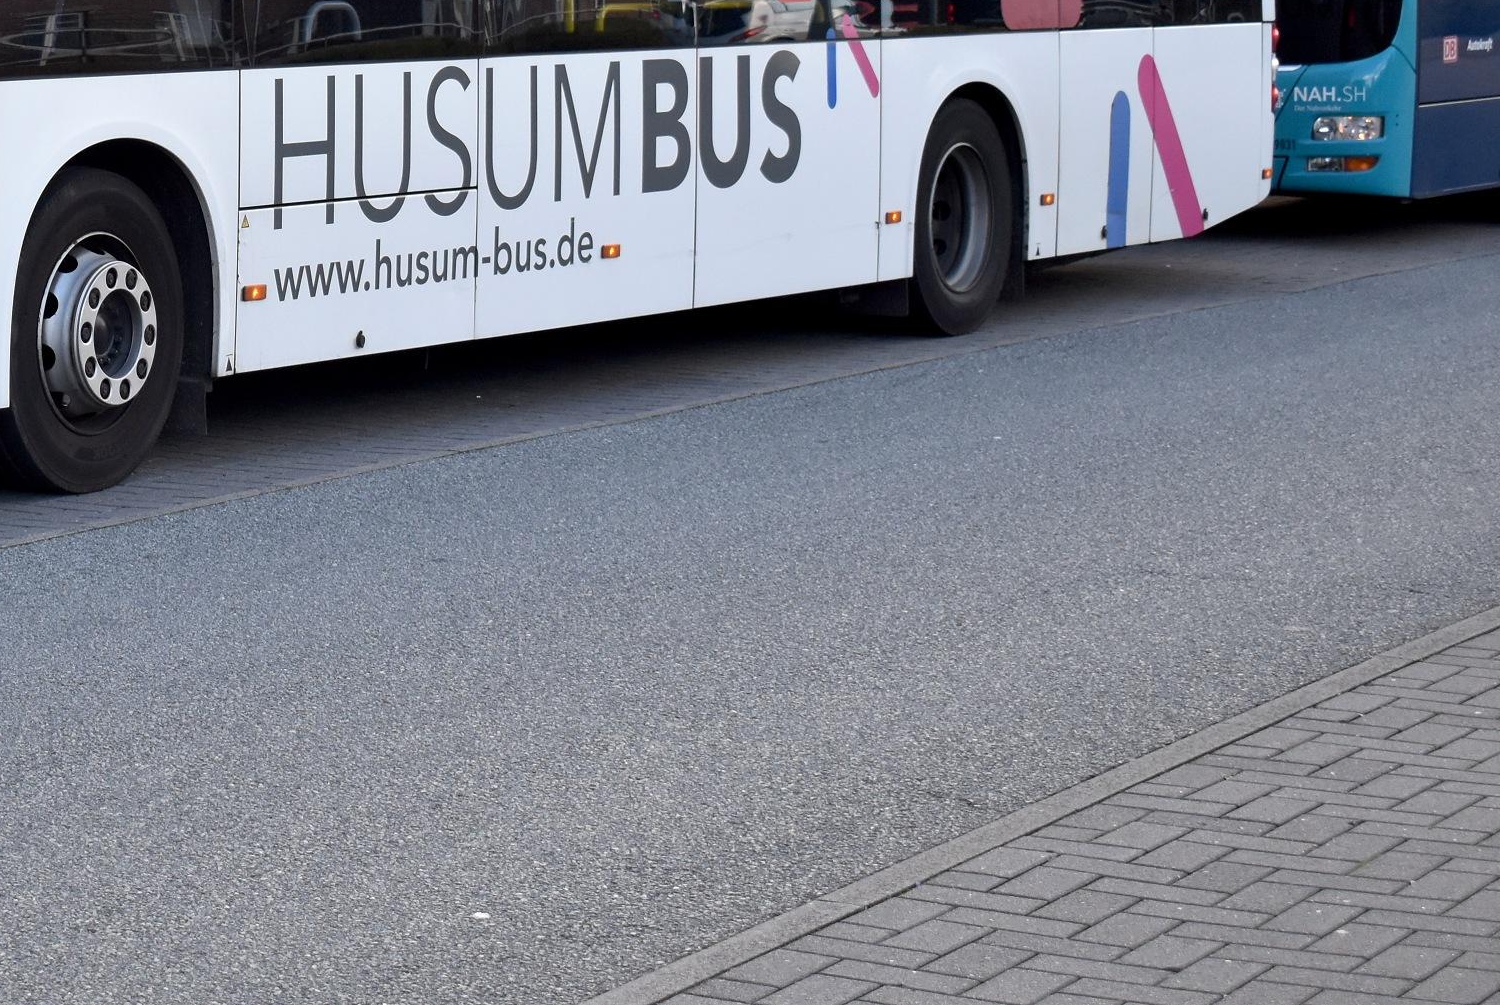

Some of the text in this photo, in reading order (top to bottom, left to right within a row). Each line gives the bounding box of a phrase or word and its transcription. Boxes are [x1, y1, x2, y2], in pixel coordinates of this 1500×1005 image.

[1444, 39, 1456, 59] DB
[1293, 85, 1367, 103] NAH.SH
[273, 49, 802, 230] HUSUMBUS
[273, 217, 595, 302] www.husum-bus.de
